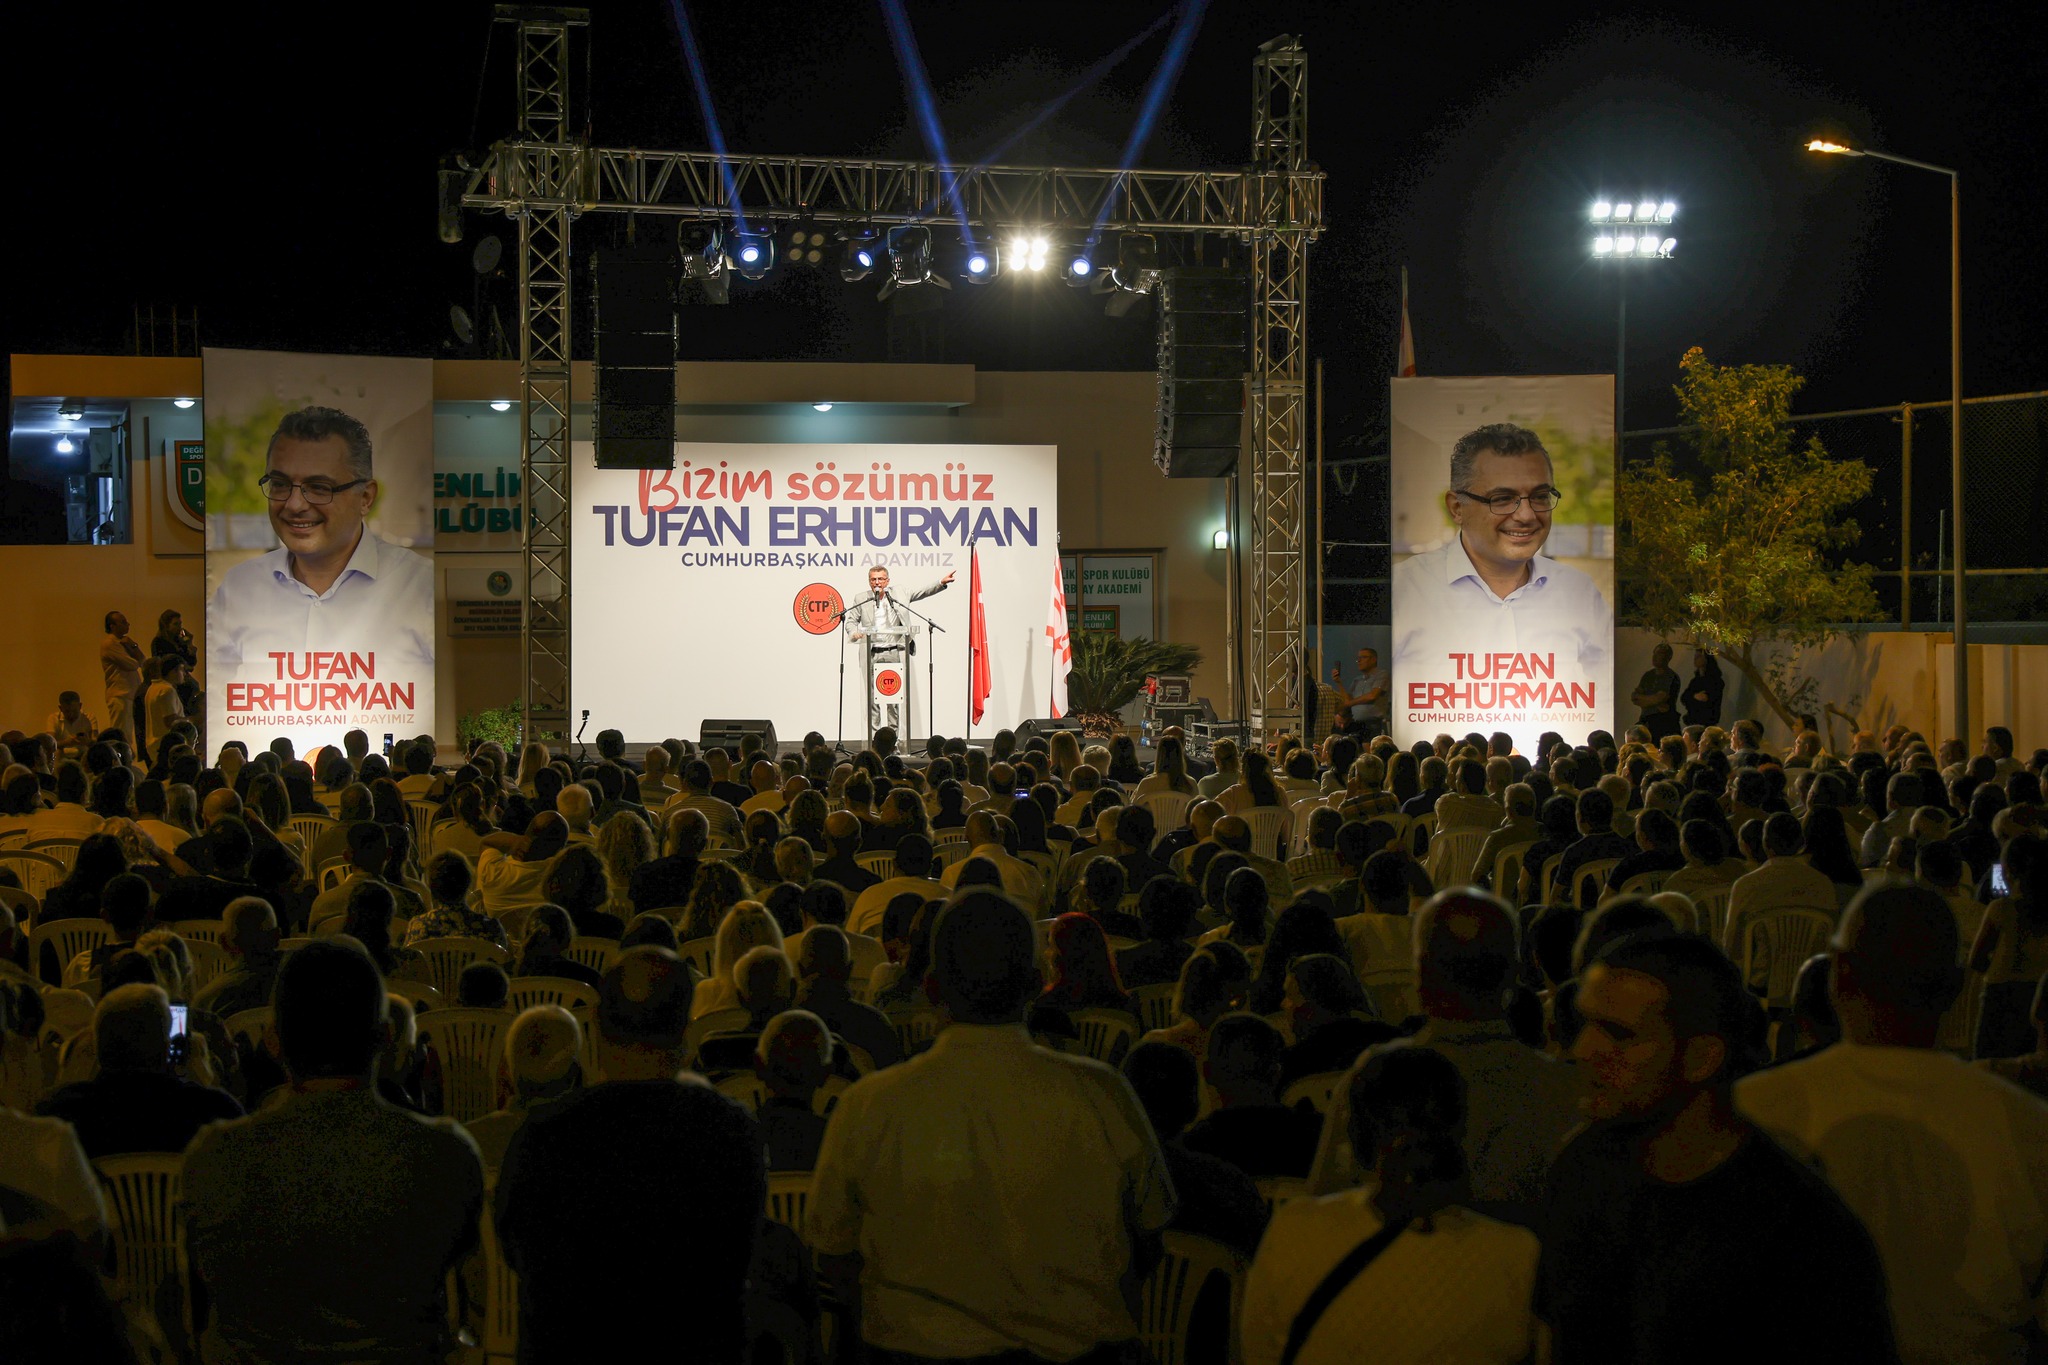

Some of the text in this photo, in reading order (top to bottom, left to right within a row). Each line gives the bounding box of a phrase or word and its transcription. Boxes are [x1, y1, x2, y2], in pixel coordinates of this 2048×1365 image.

[184, 446, 204, 454] DEĞİ
[639, 461, 994, 515] Bizim sözümüz
[434, 503, 538, 533] LÜBÜ
[593, 506, 1038, 546] TUFAN ERHÜRMAN
[682, 552, 954, 569] CUMHURBAŞKANI ADAYIMIZ
[1083, 569, 1109, 580] SPOR
[1112, 567, 1150, 580] KULÜBÜ
[1097, 581, 1142, 595] AKADEMİ
[808, 600, 829, 612] CTP
[268, 652, 375, 680] TUFAN
[1449, 653, 1554, 680] TUFAN
[227, 682, 414, 711] ERHÜRMAN
[1409, 682, 1594, 709] ERHÜRMAN
[227, 714, 415, 727] CUMHURBAŞKANI ADAYIMIZ
[1408, 713, 1595, 724] CUMHURBAŞKANI ADAYIMIZ
